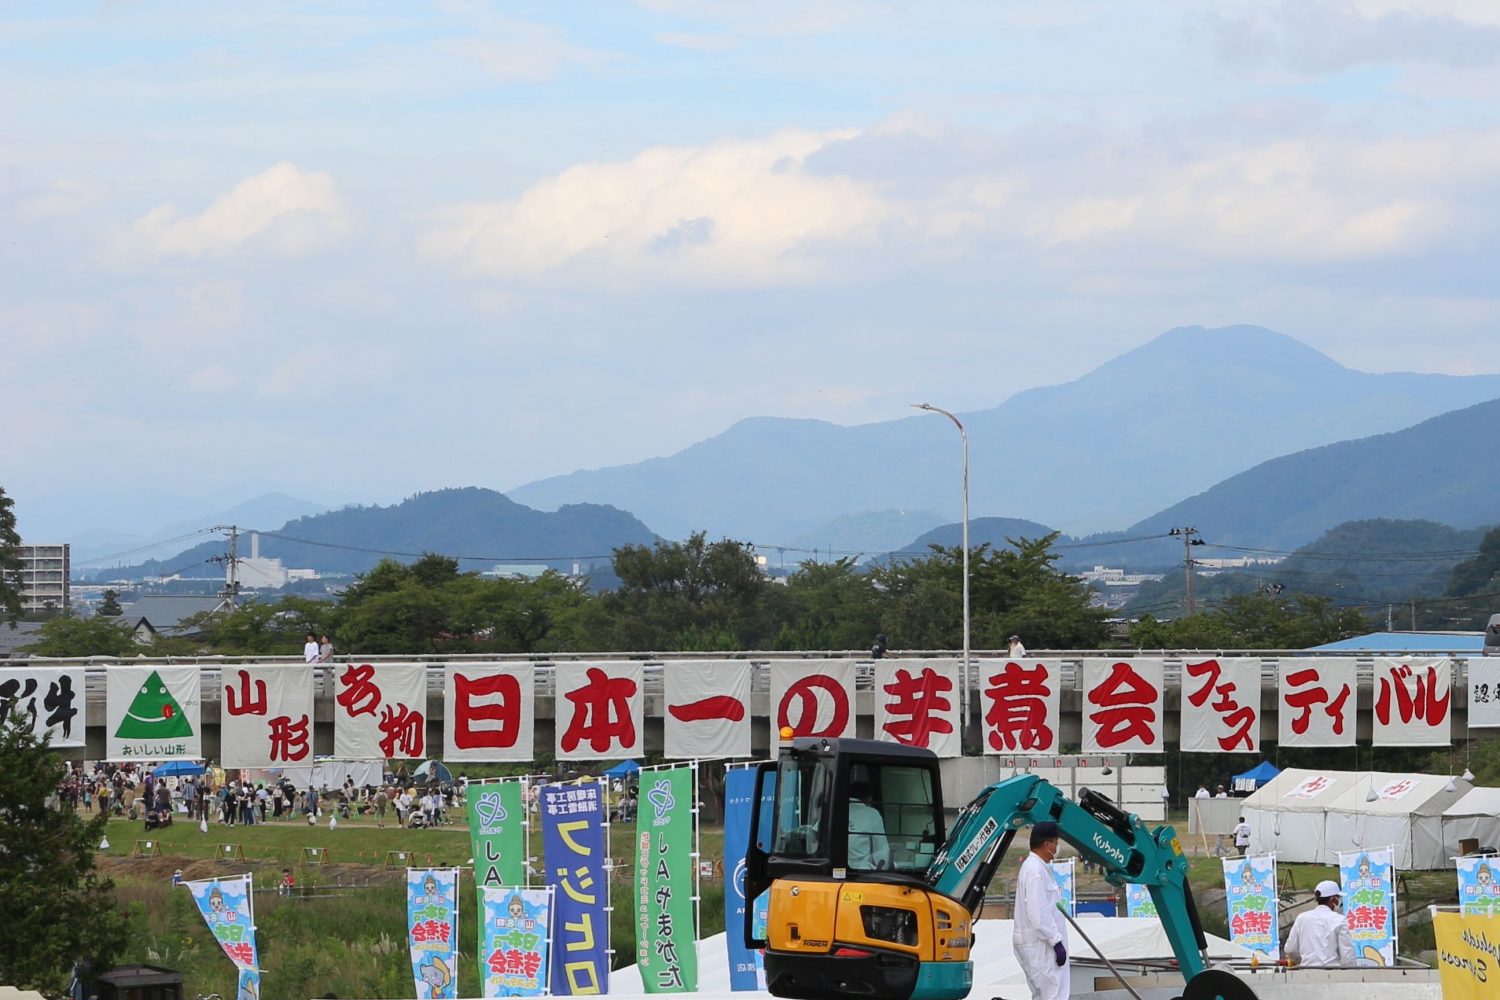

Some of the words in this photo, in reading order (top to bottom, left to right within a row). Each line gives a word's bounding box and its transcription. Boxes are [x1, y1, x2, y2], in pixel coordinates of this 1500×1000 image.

[225, 670, 310, 762] 山形
[336, 664, 425, 757] 名物
[122, 744, 187, 756] おいしい山形
[1093, 832, 1126, 864] Kubota
